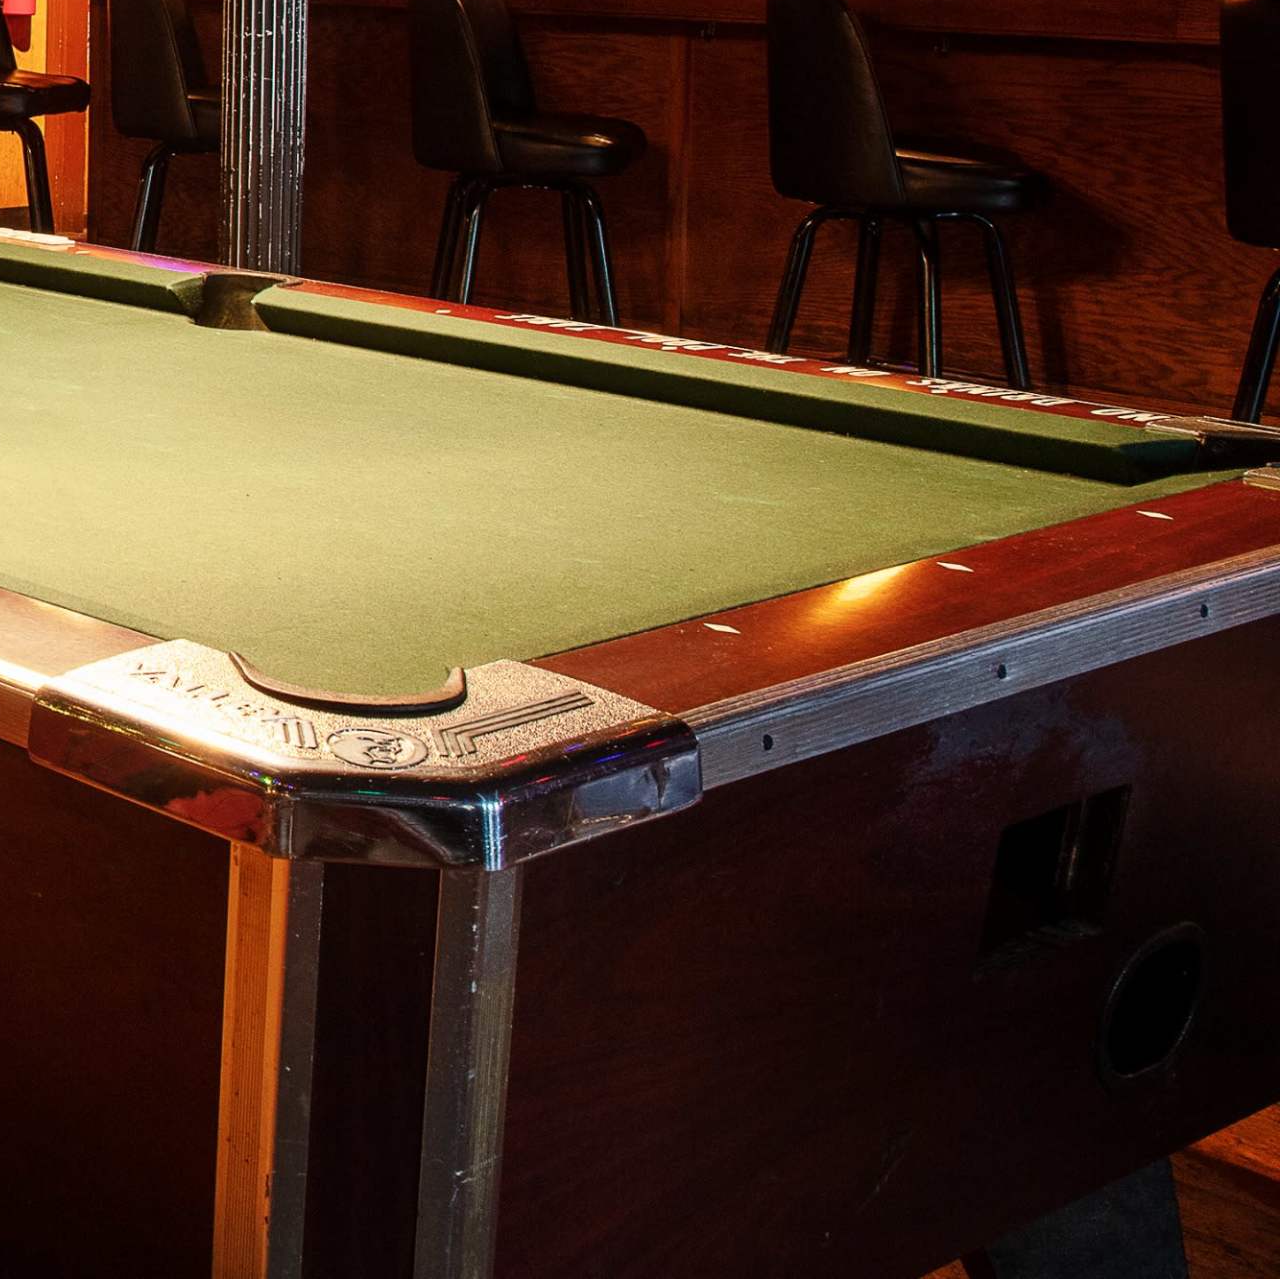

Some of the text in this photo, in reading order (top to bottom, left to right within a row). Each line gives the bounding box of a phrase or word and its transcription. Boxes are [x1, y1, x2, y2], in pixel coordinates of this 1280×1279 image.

[494, 313, 1172, 422] NO DRINKS ON THE POOL TABLE
